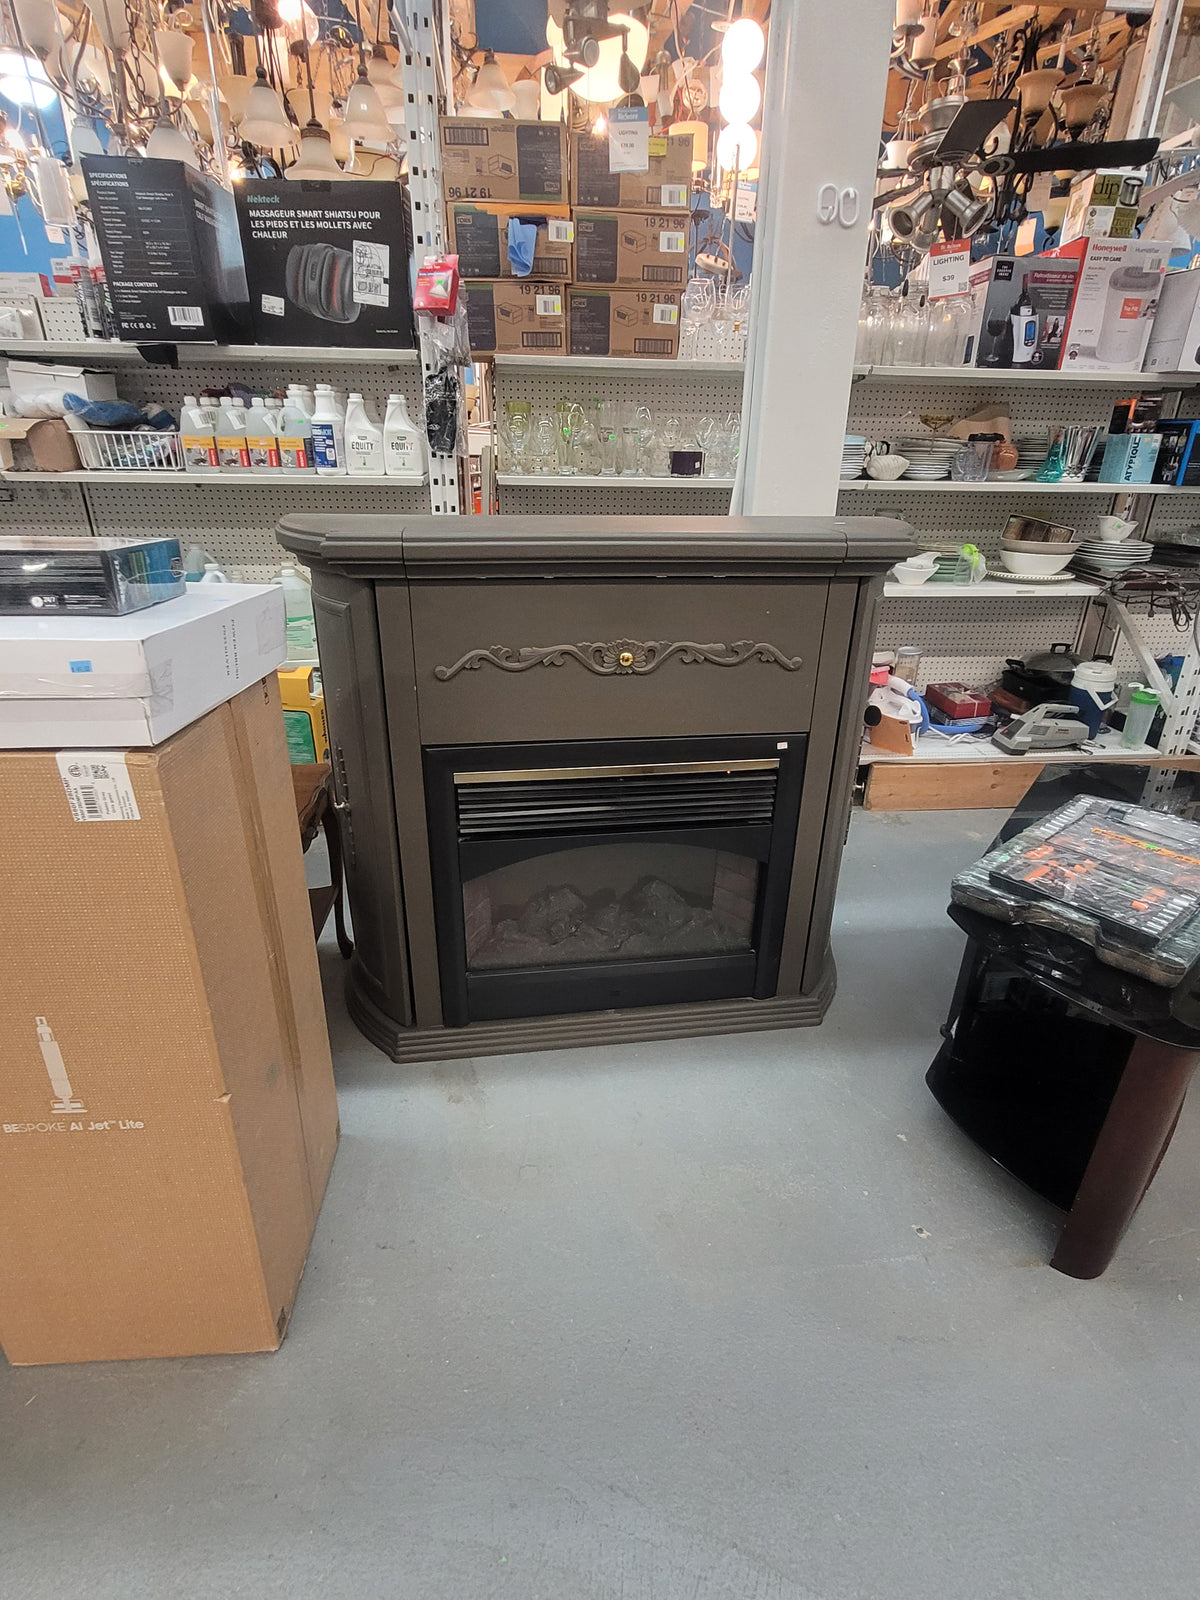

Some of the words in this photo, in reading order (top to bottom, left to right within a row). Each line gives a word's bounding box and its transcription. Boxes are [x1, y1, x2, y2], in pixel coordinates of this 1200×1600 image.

[89, 172, 128, 180] SPECIFICATIONS
[91, 180, 130, 188] SPÉCIFICATIONS
[1093, 175, 1120, 200] dip
[448, 186, 461, 198] 96
[465, 187, 477, 198] 21
[480, 187, 493, 199] 19
[246, 194, 280, 204] Nekteck
[249, 209, 296, 219] MASSAGEUR
[296, 210, 323, 219] SMART
[324, 210, 357, 219] SHIATSU
[358, 211, 381, 220] POUR
[250, 220, 265, 229] LES
[266, 220, 289, 229] PIEDS
[290, 220, 300, 229] ET
[301, 221, 315, 230] LES
[316, 221, 352, 230] MOLLETS
[352, 221, 373, 230] AVEC
[644, 217, 657, 227] 19
[658, 218, 670, 228] 21
[673, 219, 686, 229] 96
[252, 230, 288, 239] CHALEUR
[1092, 243, 1128, 253] Honeywell
[933, 254, 965, 266] LIGHTING
[942, 274, 955, 282] $39
[519, 285, 532, 295] 19
[534, 285, 545, 295] 21
[548, 286, 561, 295] 96
[636, 293, 648, 303] 19
[649, 293, 661, 303] 21
[663, 294, 676, 304] 96
[351, 441, 374, 451] EQUITY
[1123, 436, 1142, 482] ATYPIQUE
[2, 1122, 67, 1134] BESPOKE
[69, 1121, 84, 1131] AI
[118, 1119, 145, 1130] Lite
